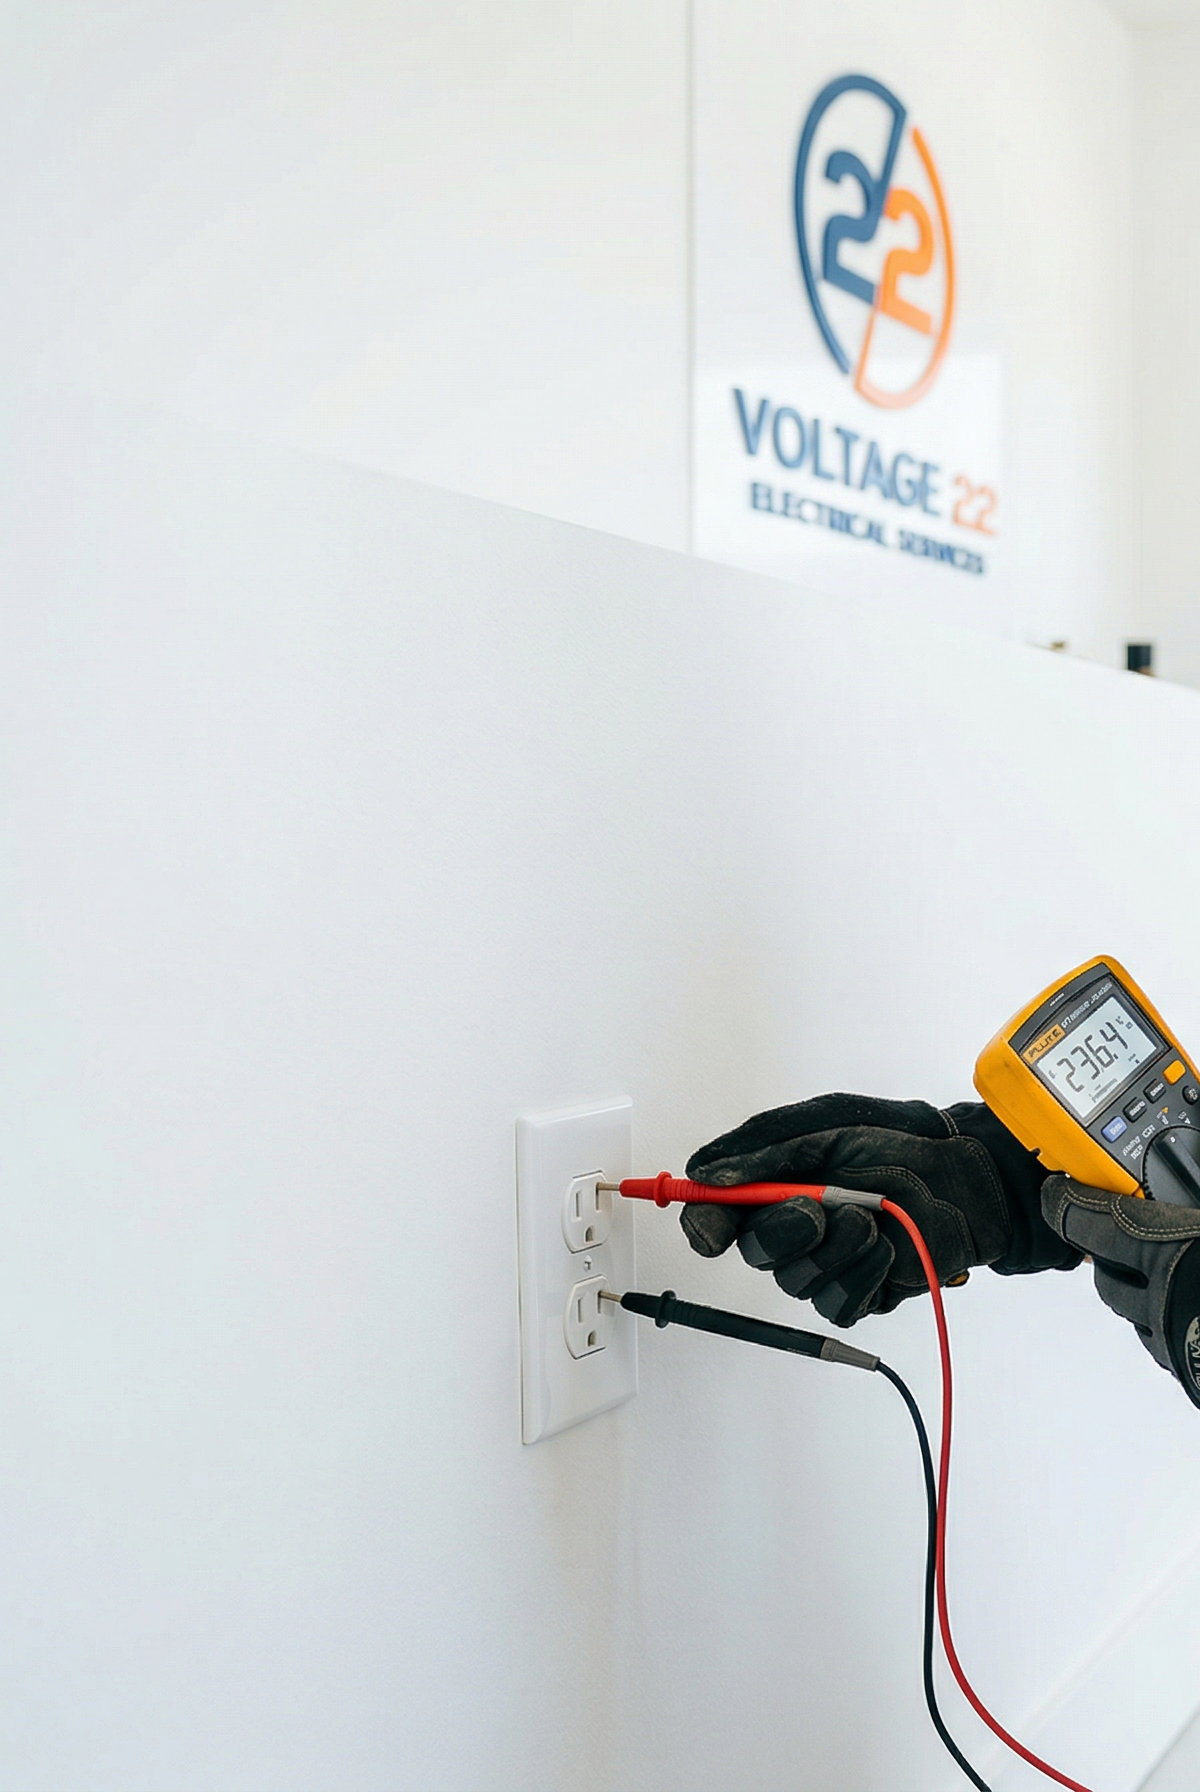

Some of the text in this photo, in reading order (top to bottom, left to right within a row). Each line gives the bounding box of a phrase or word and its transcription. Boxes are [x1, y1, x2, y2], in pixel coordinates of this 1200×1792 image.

[822, 149, 934, 337] 22
[732, 387, 997, 537] VOLTAGE 22
[1056, 1021, 1129, 1093] 236.4
